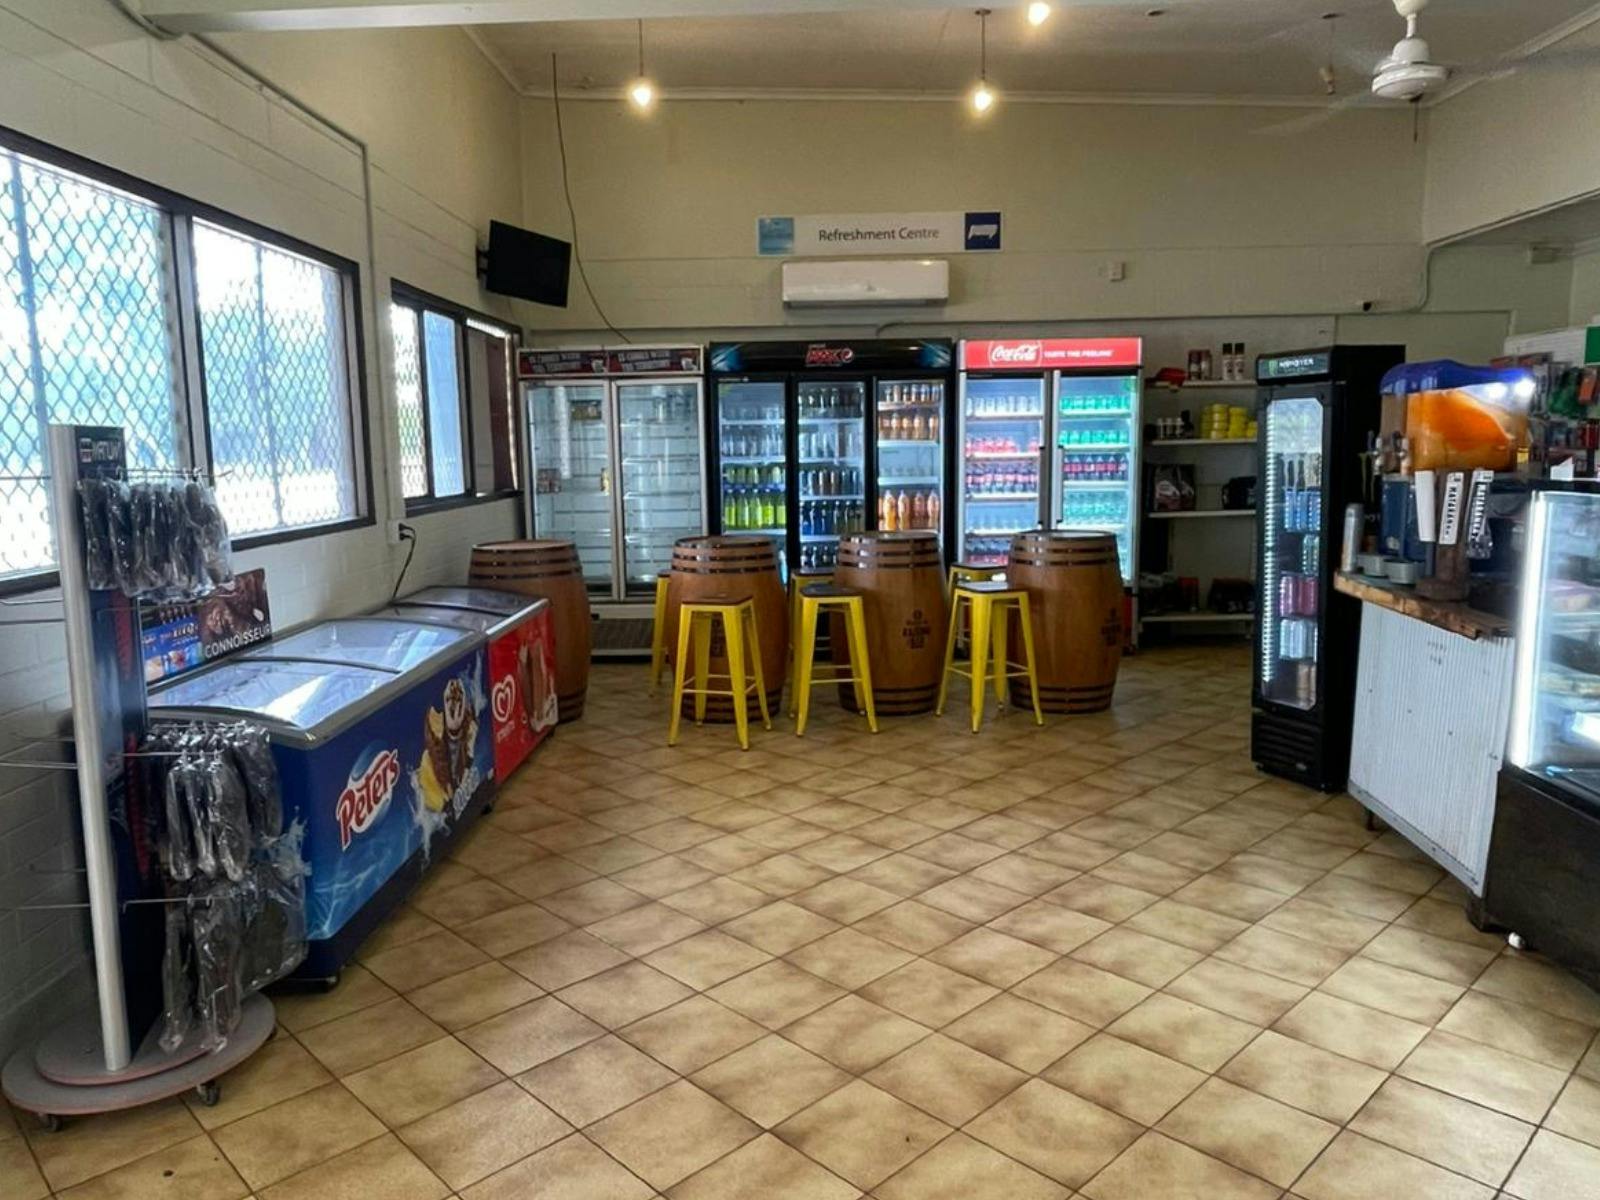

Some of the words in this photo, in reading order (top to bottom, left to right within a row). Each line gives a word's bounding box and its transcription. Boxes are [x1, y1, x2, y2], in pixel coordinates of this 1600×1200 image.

[819, 228, 896, 242] Refreshment
[898, 226, 940, 240] Centre
[204, 623, 271, 659] CONNOISSEUR
[337, 750, 399, 849] Peters
